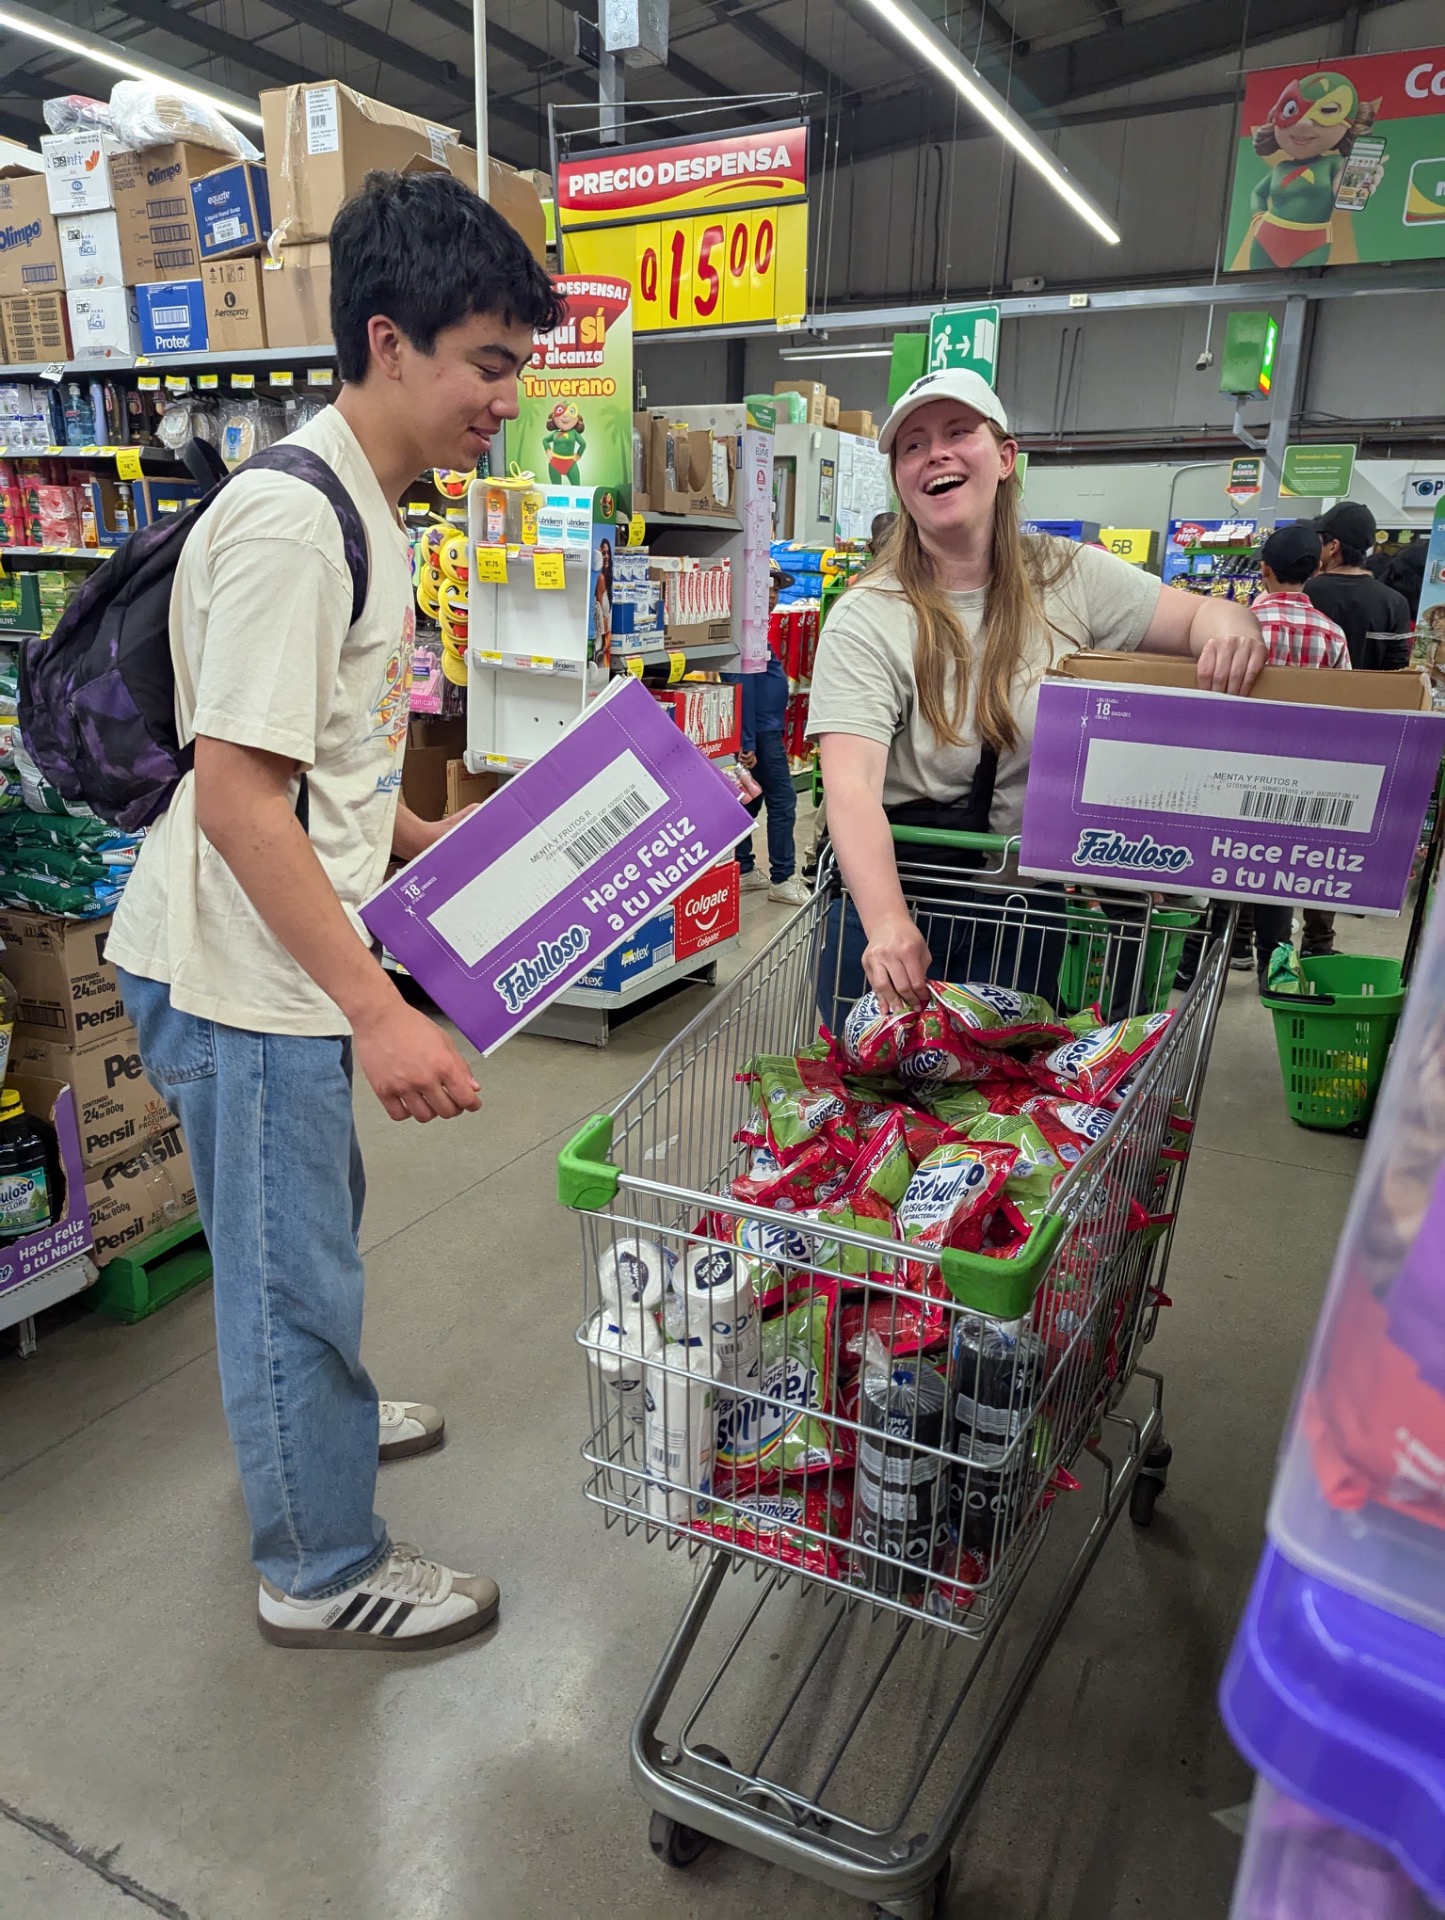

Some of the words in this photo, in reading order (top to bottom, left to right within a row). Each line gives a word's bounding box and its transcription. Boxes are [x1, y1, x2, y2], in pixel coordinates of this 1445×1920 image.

[147, 163, 182, 187] Olimpo
[568, 164, 654, 197] PRECIO
[657, 145, 792, 185] DESPENSA
[207, 190, 230, 205] equate
[218, 209, 230, 218] Hand
[229, 206, 241, 214] Soap
[0, 220, 41, 250] Olimpo
[214, 308, 249, 318] Aerospray
[580, 307, 605, 344] SÍ
[155, 335, 190, 349] Protex
[545, 350, 604, 364] alcanza
[523, 375, 546, 398] Tu
[549, 376, 617, 398] verano
[1111, 539, 1133, 555] 5B
[1095, 702, 1111, 716] 18
[1213, 772, 1244, 782] MENTA
[1246, 774, 1253, 783] Y
[1254, 775, 1291, 787] FRUTOS
[1292, 779, 1299, 787] R
[530, 842, 554, 864] MENTA
[558, 815, 587, 840] FRUTOS
[1074, 829, 1193, 872] Fabuloso
[1210, 836, 1283, 864] Hace
[1289, 844, 1365, 873] Feliz
[582, 863, 641, 914] Hace
[637, 816, 696, 867] Feliz
[404, 884, 421, 900] 18
[607, 913, 625, 931] a
[621, 889, 651, 918] tu
[647, 841, 709, 895] Nariz
[1210, 867, 1229, 885] a
[1235, 867, 1266, 889] tu
[1273, 870, 1352, 899] Nariz
[684, 887, 729, 917] Colgate
[696, 930, 721, 948] Colgate
[495, 925, 590, 1011] Fabuloso
[72, 983, 90, 1000] 24
[97, 982, 116, 994] 800g
[89, 977, 105, 986] PIEZAS
[577, 976, 603, 987] otex
[75, 1000, 124, 1031] Persil
[83, 1107, 100, 1125] 24
[105, 1103, 124, 1116] 800g
[98, 1099, 114, 1109] PIEZAS
[143, 1106, 168, 1122] ACCIÓN
[86, 1118, 136, 1154] Persil
[101, 1126, 183, 1191] Persil
[0, 1179, 34, 1204] uloso
[5, 1198, 28, 1212] CLORO
[88, 1209, 106, 1227] 24
[111, 1202, 131, 1216] 800g
[102, 1199, 118, 1211] PIEZAS
[902, 1200, 935, 1215] FUSIÓN
[19, 1233, 52, 1261] Hace
[54, 1218, 84, 1244] Feliz
[94, 1216, 145, 1255] Persil
[23, 1261, 32, 1275] a
[33, 1253, 49, 1269] tu
[51, 1235, 85, 1260] Nariz
[717, 1367, 822, 1450] Fabulos
